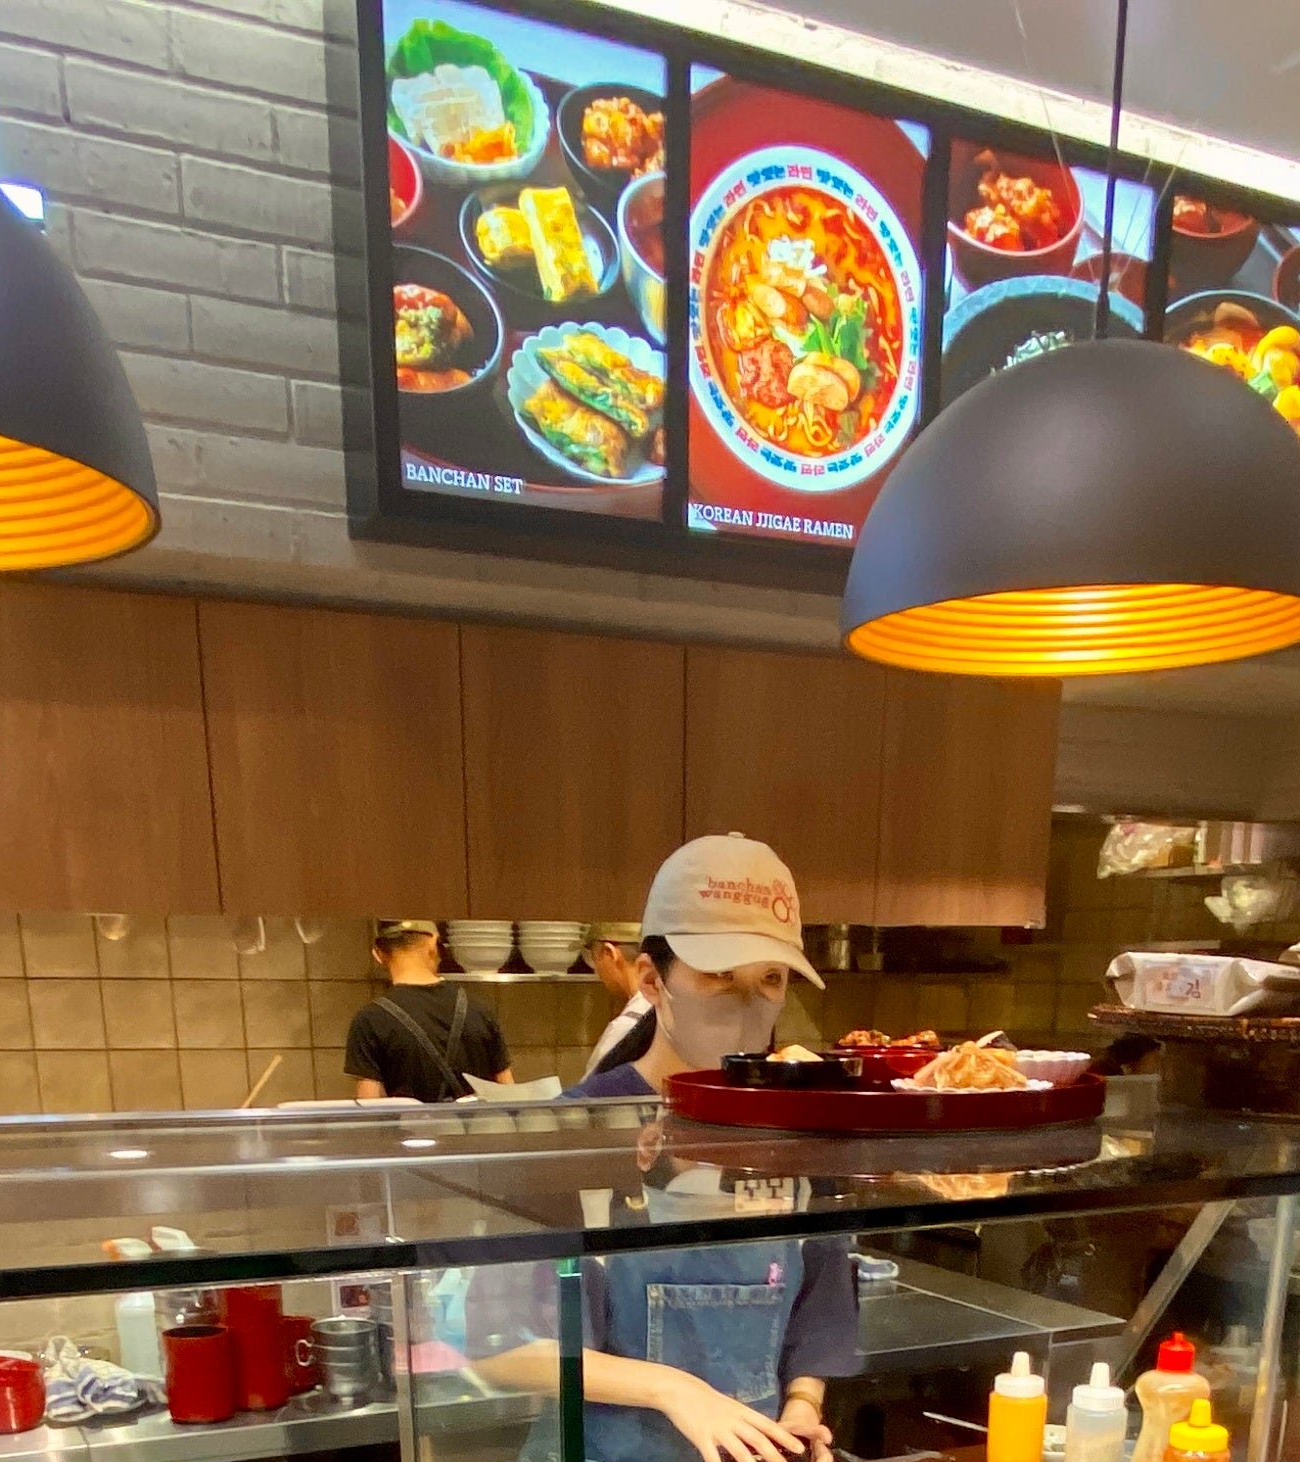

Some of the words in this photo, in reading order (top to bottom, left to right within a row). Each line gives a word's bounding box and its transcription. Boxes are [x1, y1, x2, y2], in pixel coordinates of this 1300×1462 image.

[405, 463, 490, 492] BANCHAN
[493, 475, 523, 495] SET
[694, 501, 753, 527] KOREAN
[756, 510, 801, 532] JJIGAE
[804, 518, 854, 539] RAMEN
[707, 875, 772, 896] banchan
